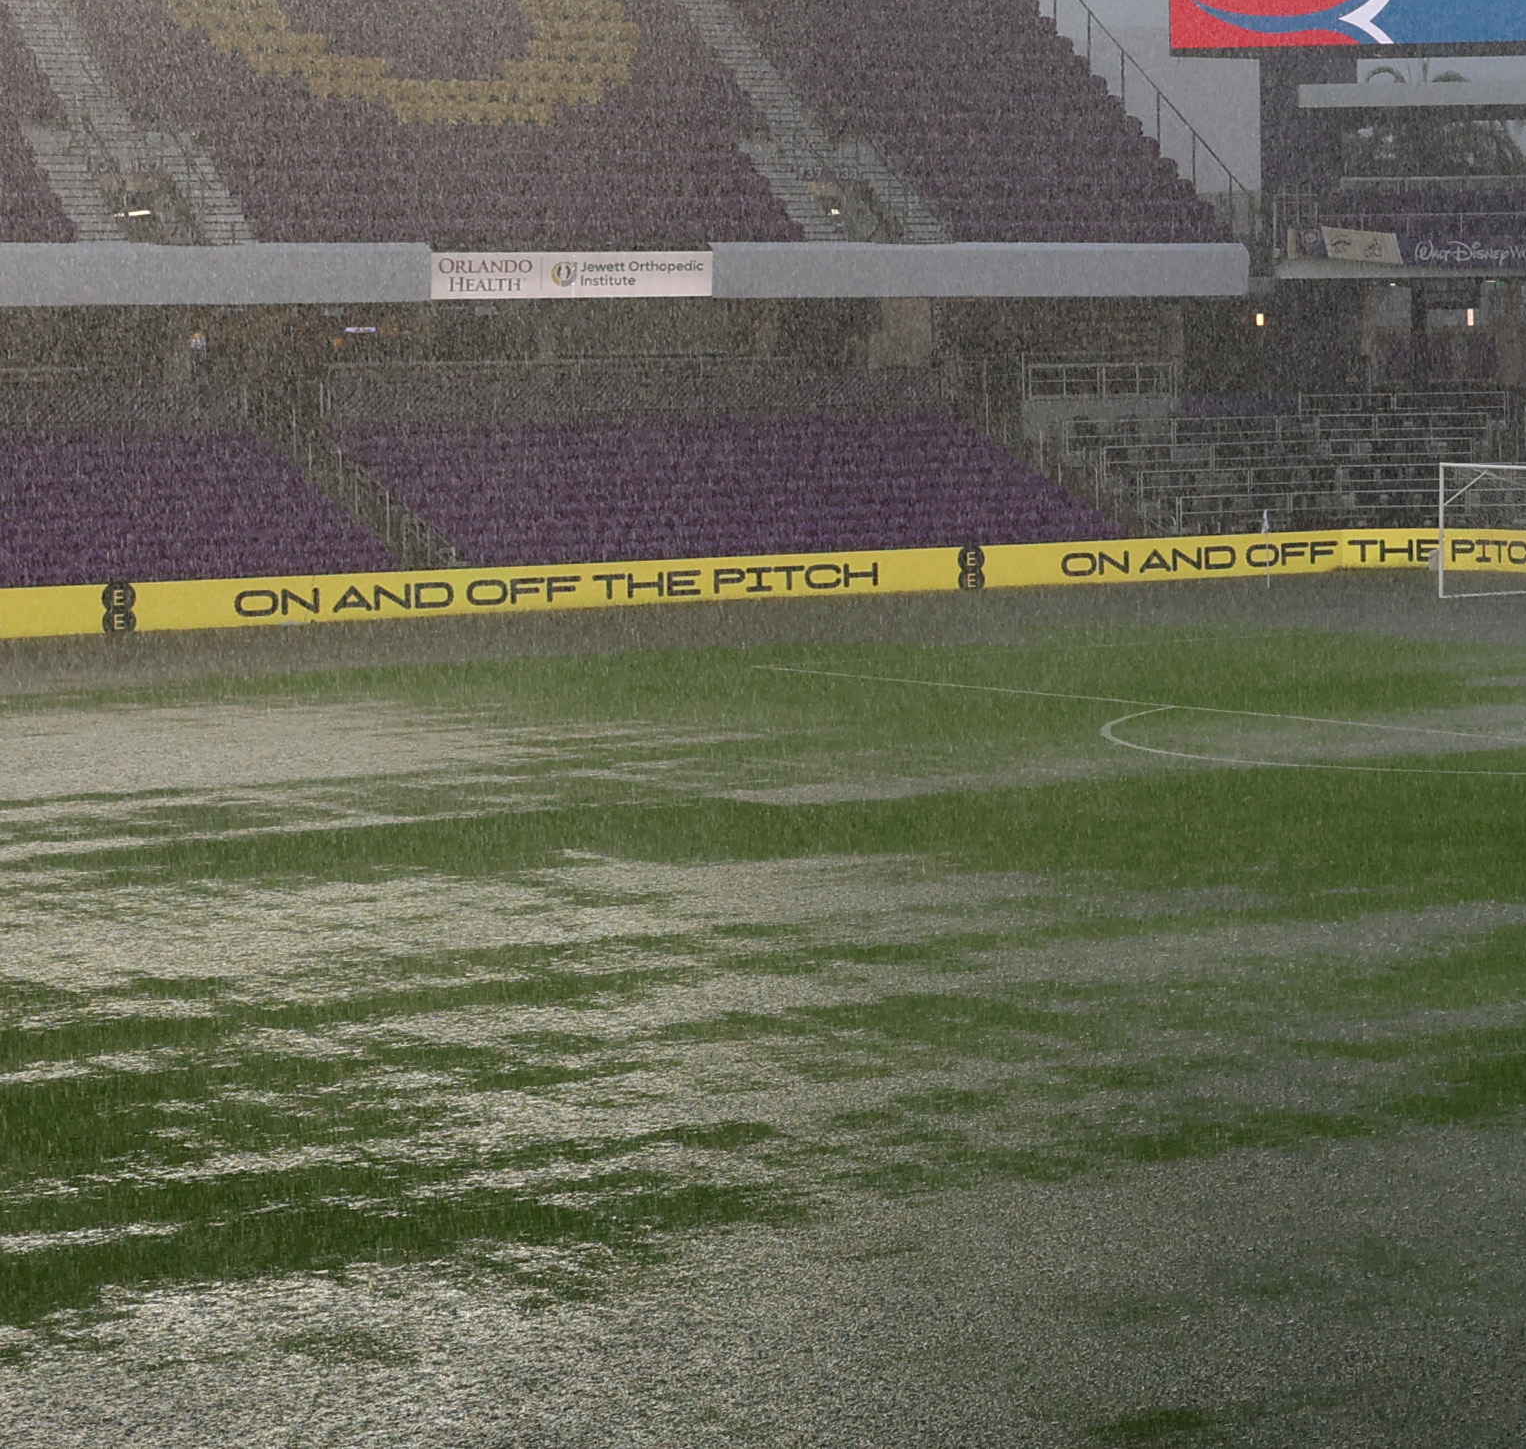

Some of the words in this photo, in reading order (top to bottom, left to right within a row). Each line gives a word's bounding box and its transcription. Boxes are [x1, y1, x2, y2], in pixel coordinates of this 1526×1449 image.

[580, 260, 627, 273] Jewett
[628, 259, 704, 273] Orthopedic
[580, 274, 636, 287] Institute
[1061, 551, 1129, 577] ON
[1140, 546, 1236, 573] AND
[1246, 541, 1338, 567] OFF
[1348, 539, 1440, 563] THE
[235, 588, 319, 617] ON
[333, 582, 453, 613] AND
[467, 576, 581, 605] OFF
[593, 570, 701, 599] THE
[714, 563, 879, 593] PITCH
